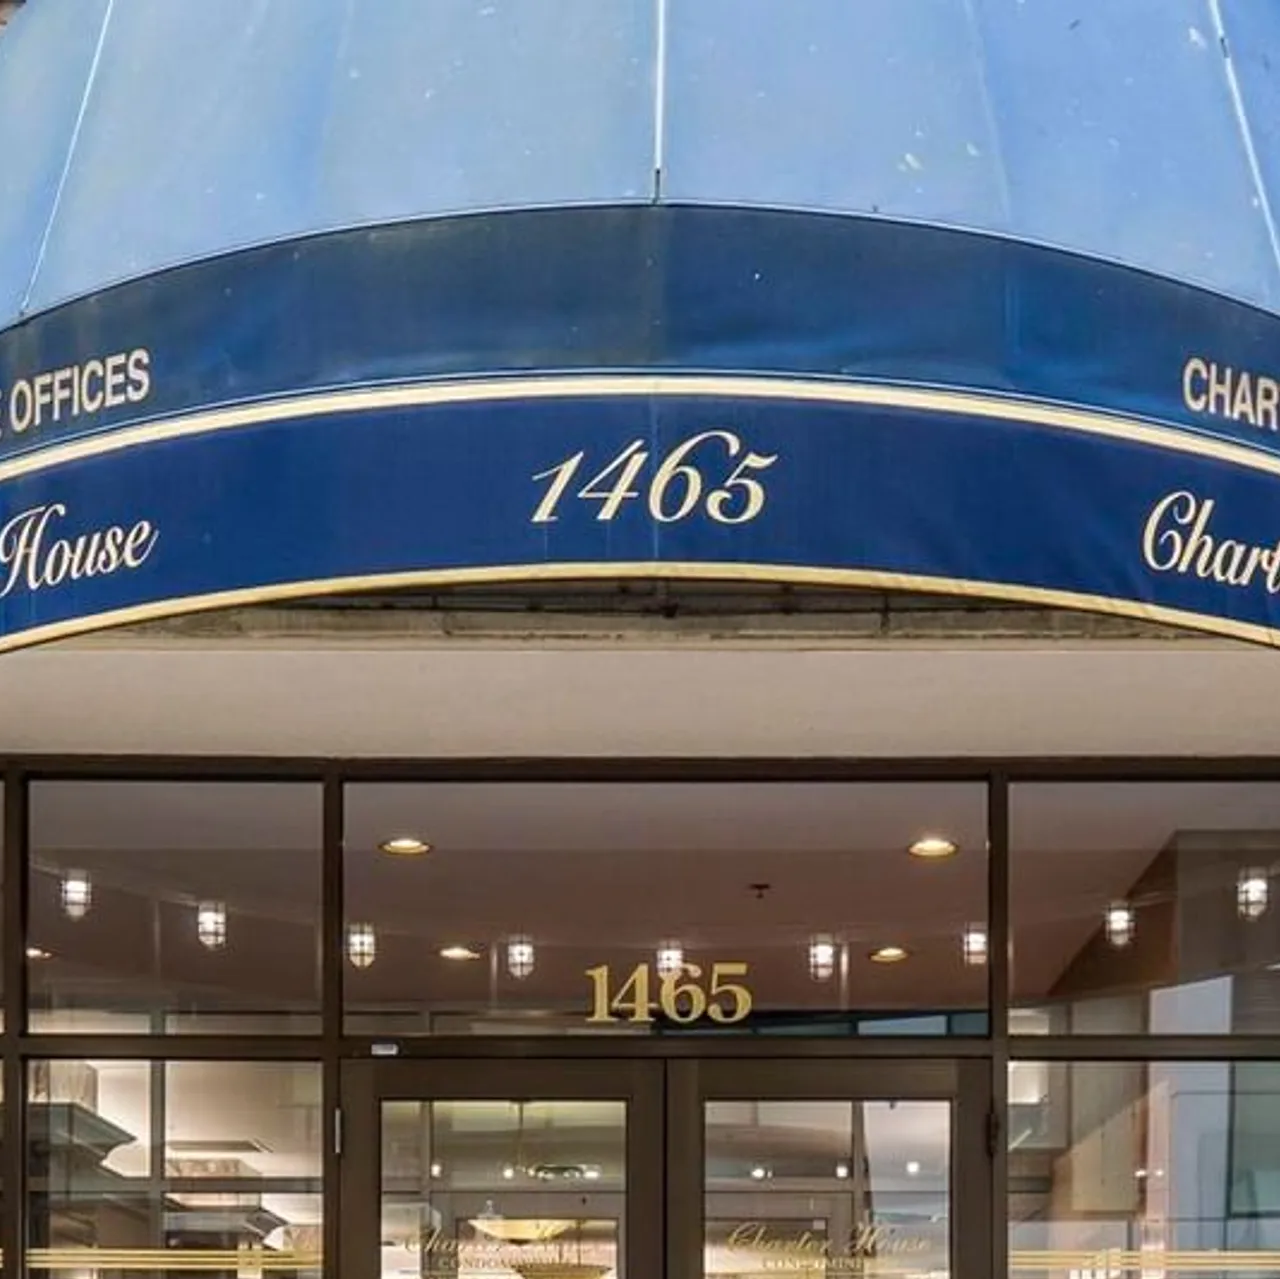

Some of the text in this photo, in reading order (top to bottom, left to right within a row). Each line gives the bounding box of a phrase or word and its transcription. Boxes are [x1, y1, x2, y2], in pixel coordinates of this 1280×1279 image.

[9, 348, 150, 433] OFFICES
[531, 430, 778, 523] 1465
[584, 961, 753, 1023] 1465
